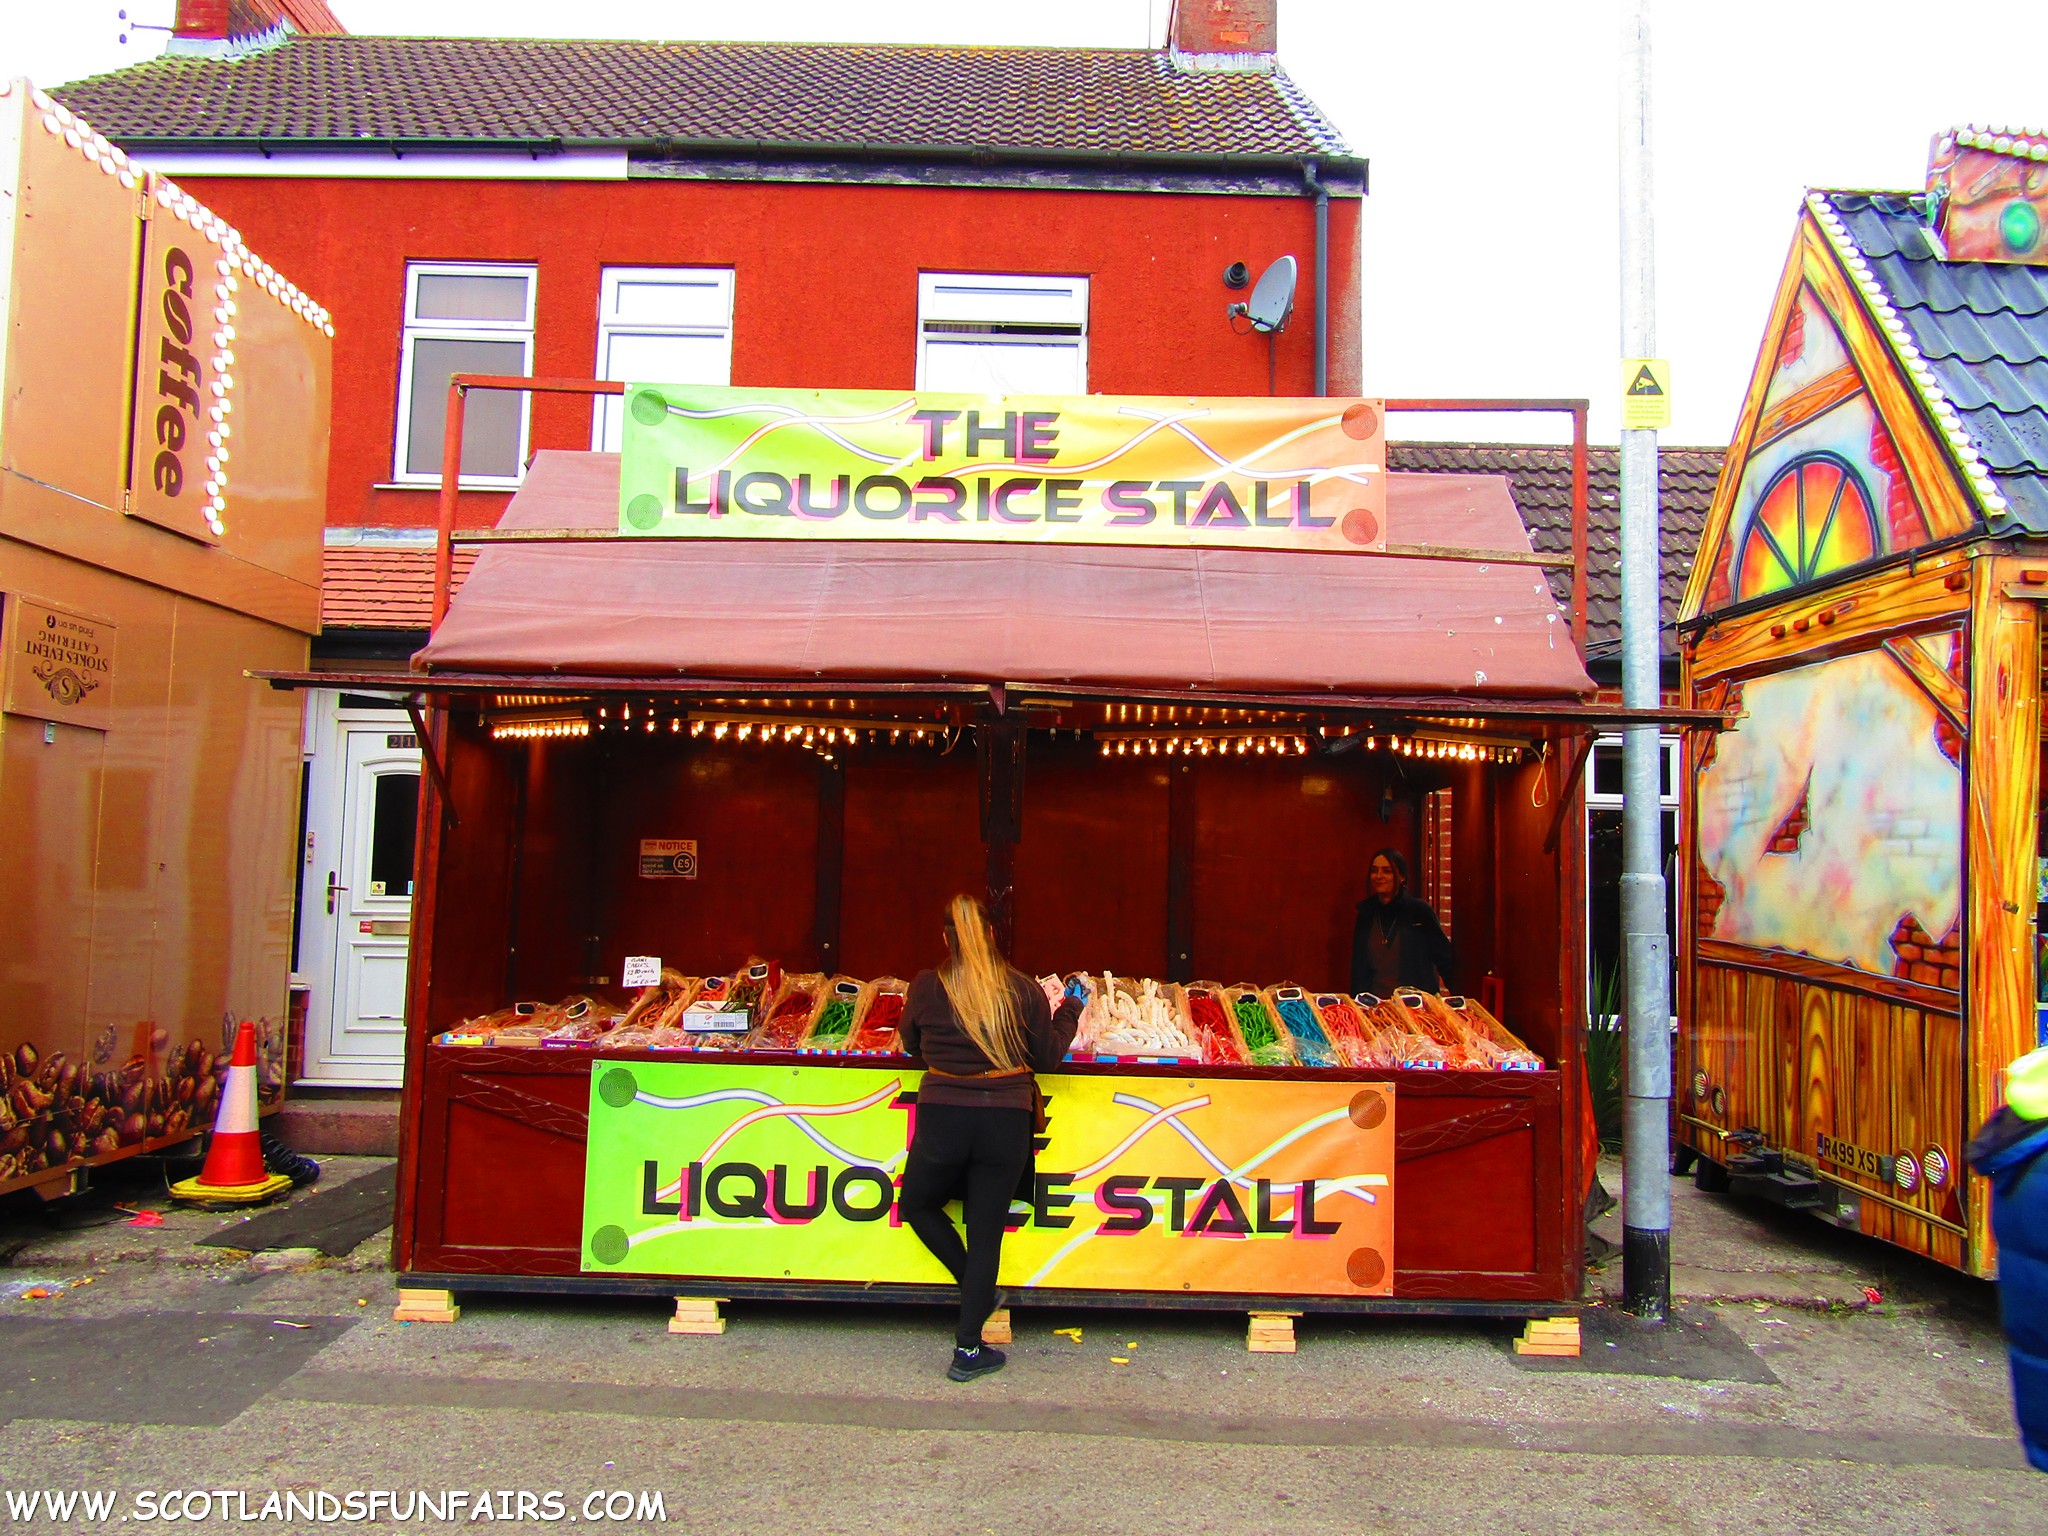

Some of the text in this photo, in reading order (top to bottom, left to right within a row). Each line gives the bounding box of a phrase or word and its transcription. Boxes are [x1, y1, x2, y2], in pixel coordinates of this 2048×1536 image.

[154, 246, 200, 498] coffee
[906, 410, 1061, 464] THE
[675, 467, 1336, 528] LIQUORICE STALL
[39, 630, 99, 654] CATERING
[79, 626, 94, 638] Find
[25, 640, 109, 672] STOKES EVENT
[658, 842, 693, 850] NOTICE
[677, 859, 690, 868] £5
[1824, 1137, 1854, 1166] R499
[642, 1159, 1342, 1239] LIQUOE STALL
